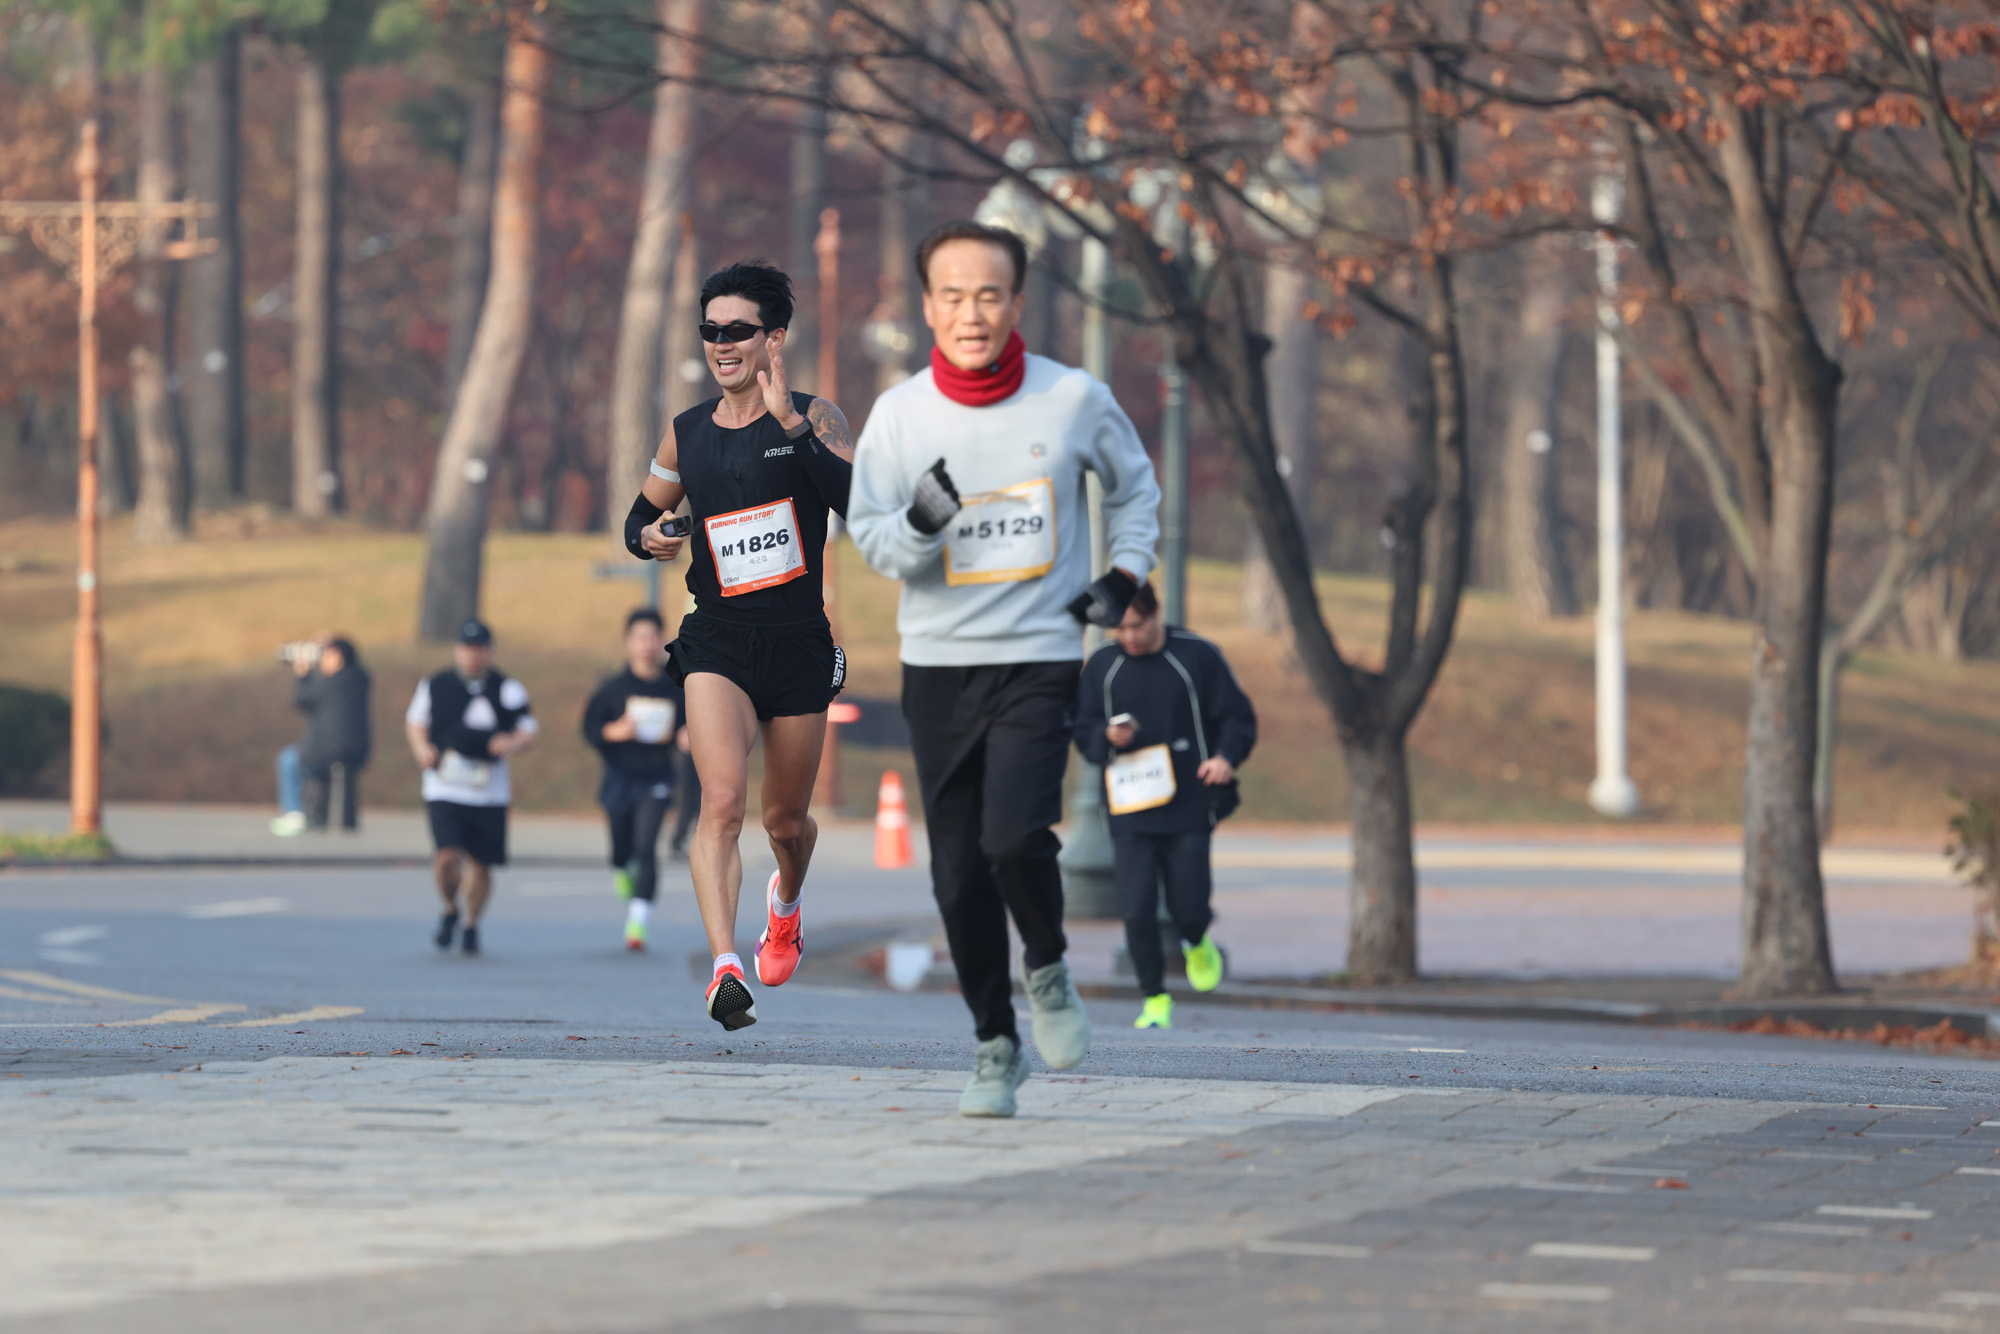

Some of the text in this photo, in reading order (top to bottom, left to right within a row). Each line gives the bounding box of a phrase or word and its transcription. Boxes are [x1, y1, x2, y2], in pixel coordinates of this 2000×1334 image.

[710, 518, 738, 530] BURNING
[738, 514, 753, 523] RUN
[753, 508, 776, 520] STORY
[957, 515, 1043, 539] M5129
[721, 528, 790, 557] M1826
[723, 576, 740, 585] 10km
